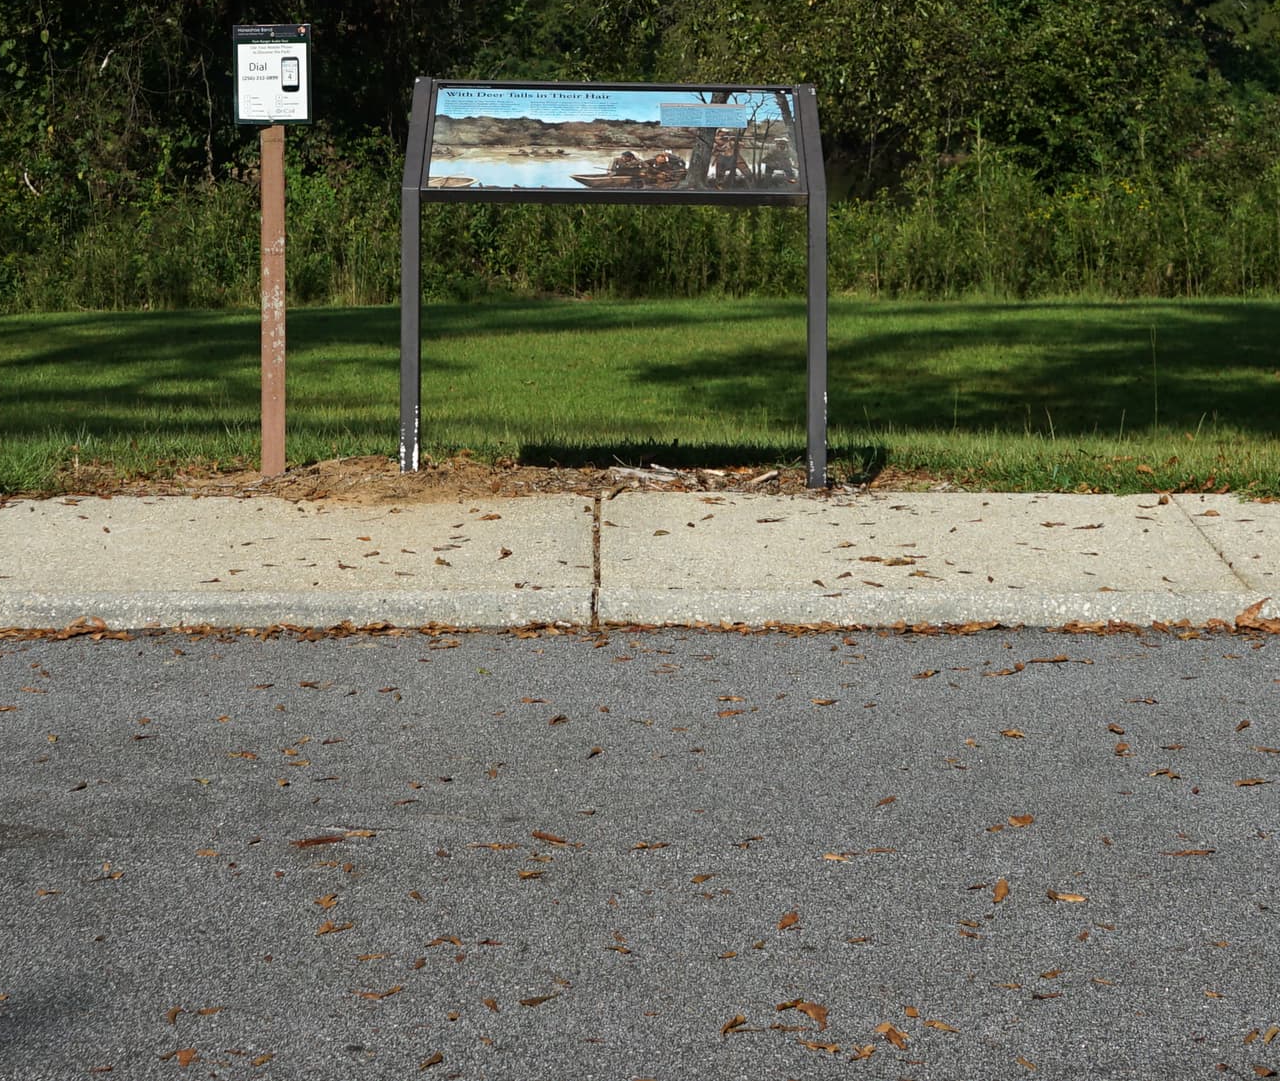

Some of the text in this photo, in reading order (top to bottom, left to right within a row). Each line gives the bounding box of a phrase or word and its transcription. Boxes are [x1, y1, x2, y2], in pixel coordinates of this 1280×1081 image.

[249, 62, 267, 72] Dial
[509, 91, 534, 99] Tails
[536, 91, 548, 99] in
